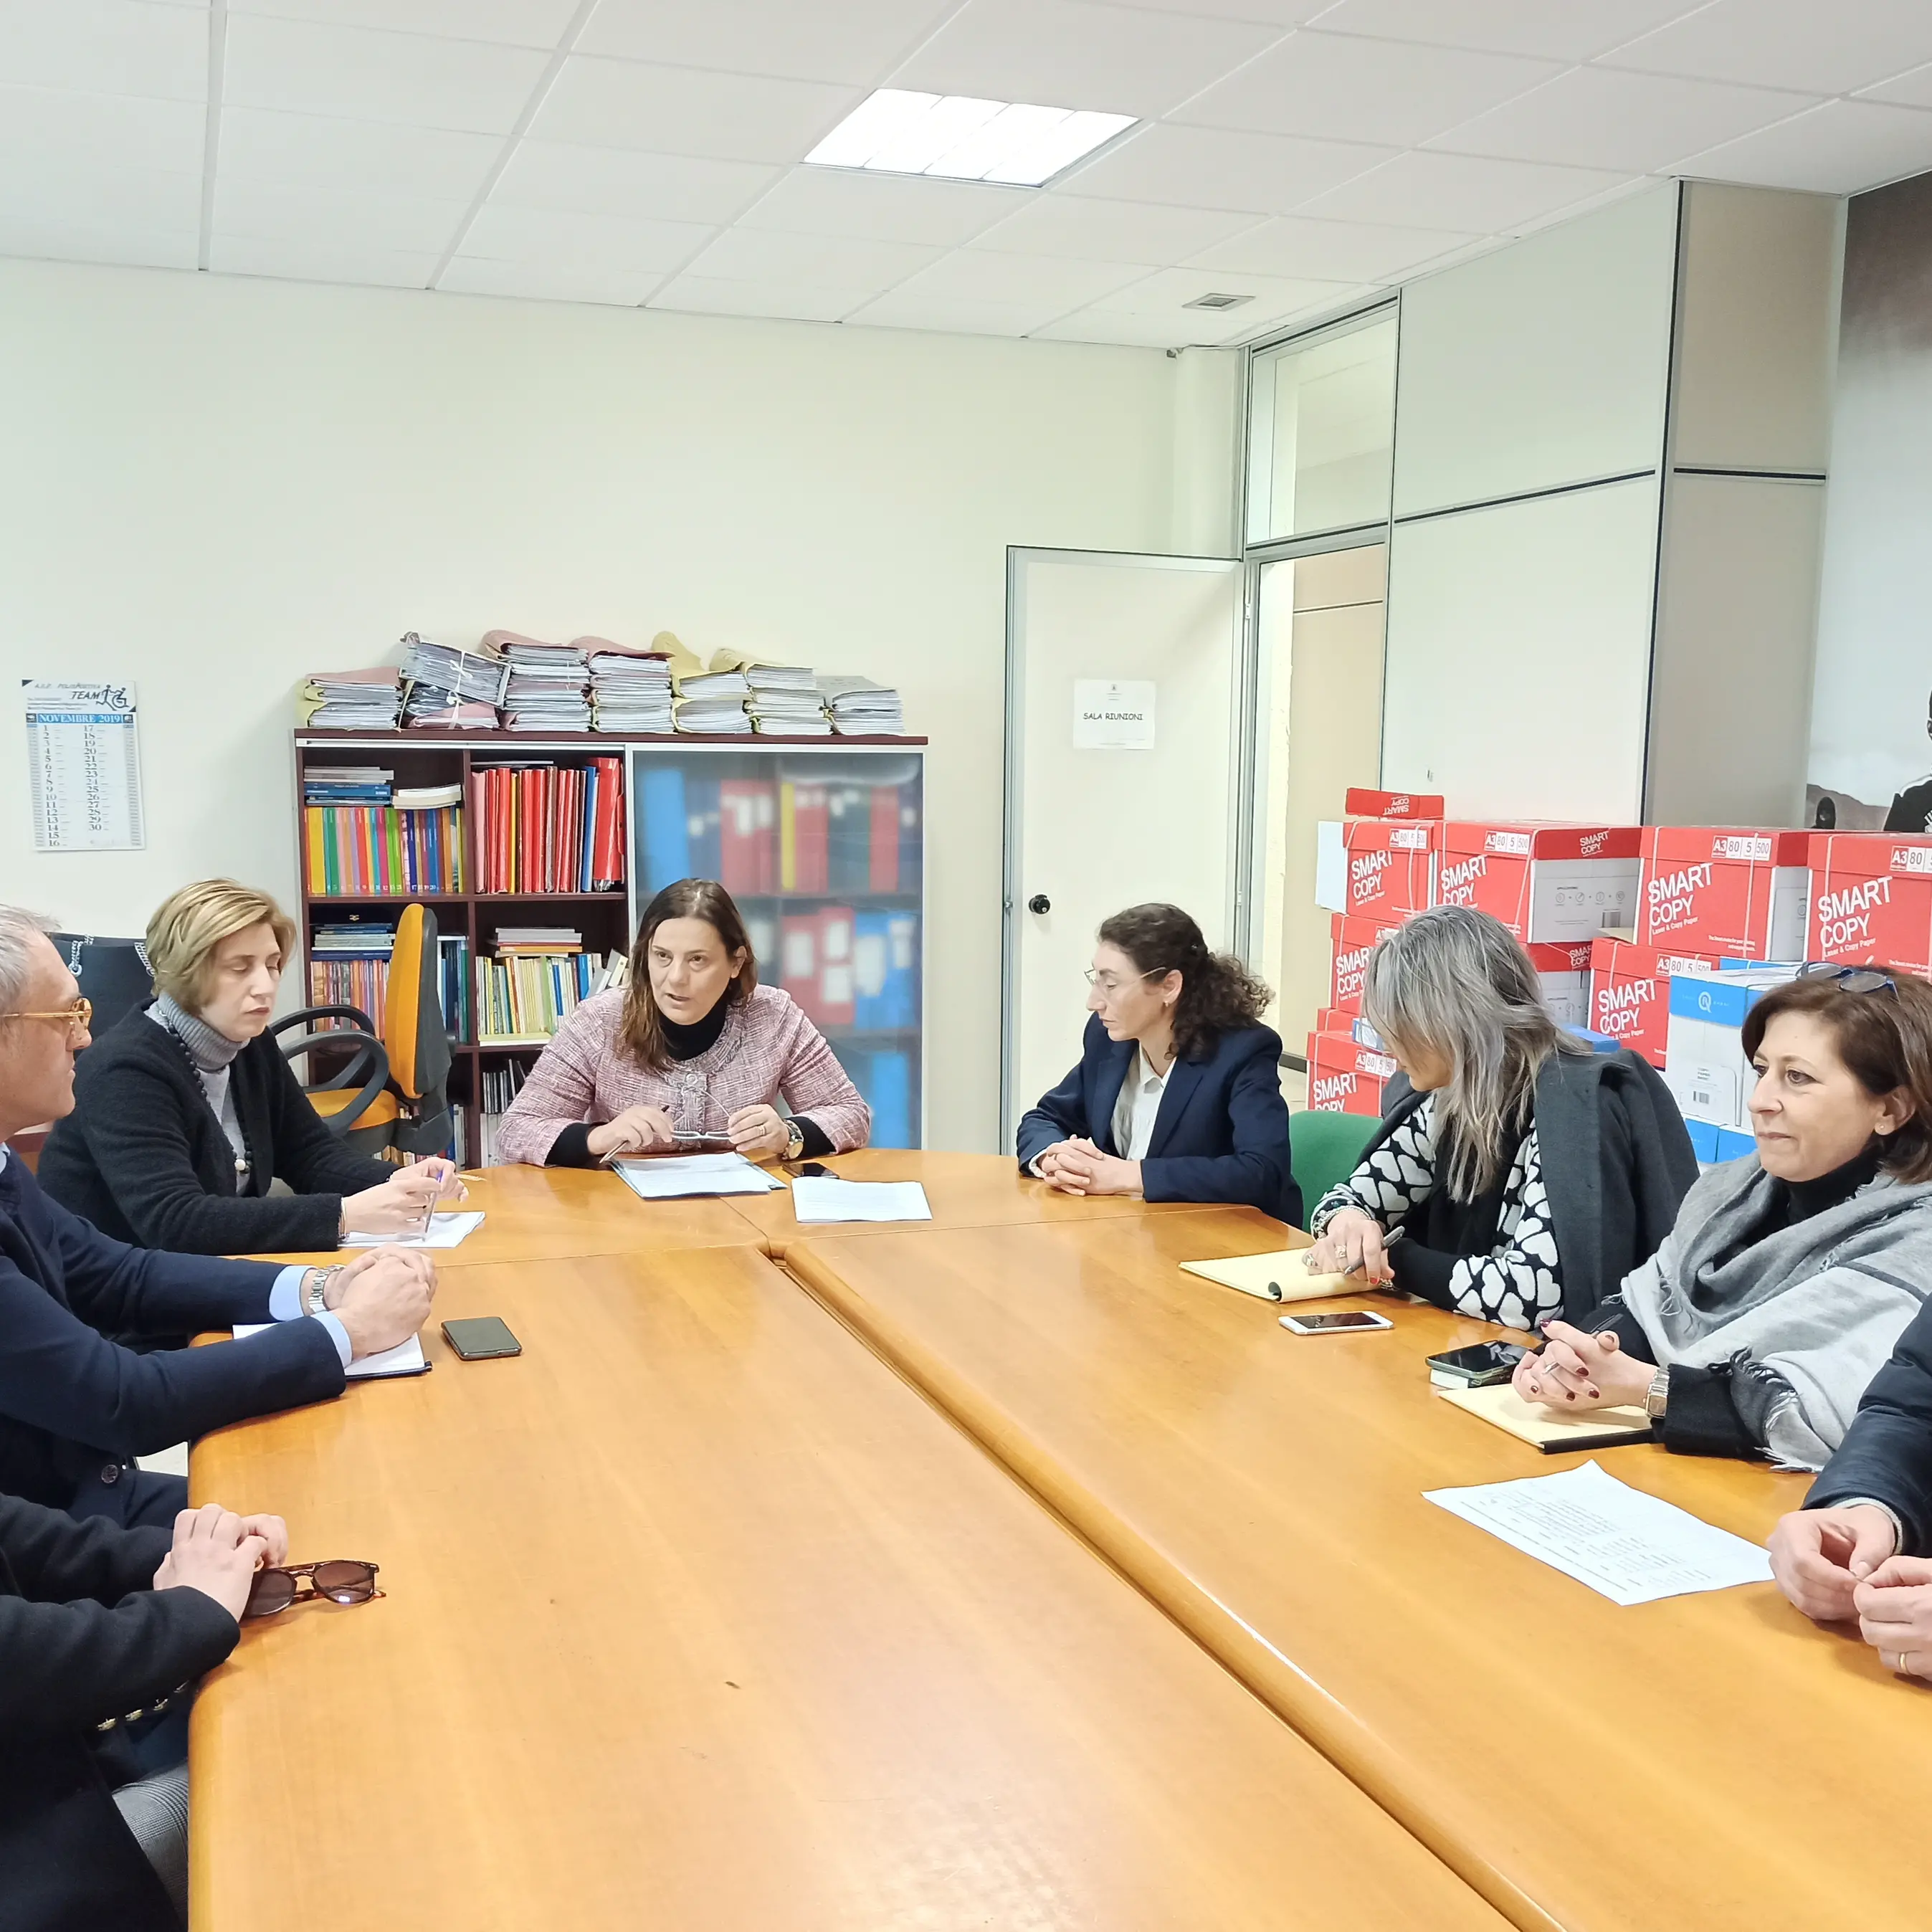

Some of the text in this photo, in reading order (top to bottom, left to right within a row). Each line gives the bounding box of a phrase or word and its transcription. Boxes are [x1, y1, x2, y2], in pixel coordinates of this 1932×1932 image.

[71, 691, 100, 700] TEAM
[39, 714, 120, 723] NOVEMBRE 2019
[1383, 804, 1409, 816] SMART
[1391, 797, 1409, 806] COPY
[1485, 834, 1496, 844] A3
[1497, 835, 1505, 846] 80
[1510, 837, 1515, 847] 5
[1579, 831, 1609, 847] SMART
[1581, 842, 1601, 855] COPY
[1713, 839, 1769, 854] A3 80 5 500
[1351, 850, 1392, 880] SMART
[1892, 850, 1923, 865] A3 80
[1441, 855, 1488, 890] SMART
[1647, 862, 1713, 904] SMART
[1353, 872, 1382, 899] COPY
[1443, 882, 1475, 905] COPY
[1650, 895, 1694, 926] COPY
[1817, 876, 1893, 923] SMART
[1820, 913, 1870, 948] COPY
[1845, 943, 1859, 951] Copy
[1860, 938, 1876, 947] Paper
[1336, 947, 1371, 976] SMAR
[1657, 958, 1670, 970] A3
[1671, 960, 1681, 972] 80
[1688, 963, 1693, 972] 5
[1338, 970, 1365, 994] COPY
[1598, 979, 1656, 1013] SMART
[1599, 1007, 1640, 1034] COPY
[1356, 1052, 1366, 1063] A3
[1367, 1055, 1375, 1067] 80
[1313, 1072, 1357, 1102] SMART
